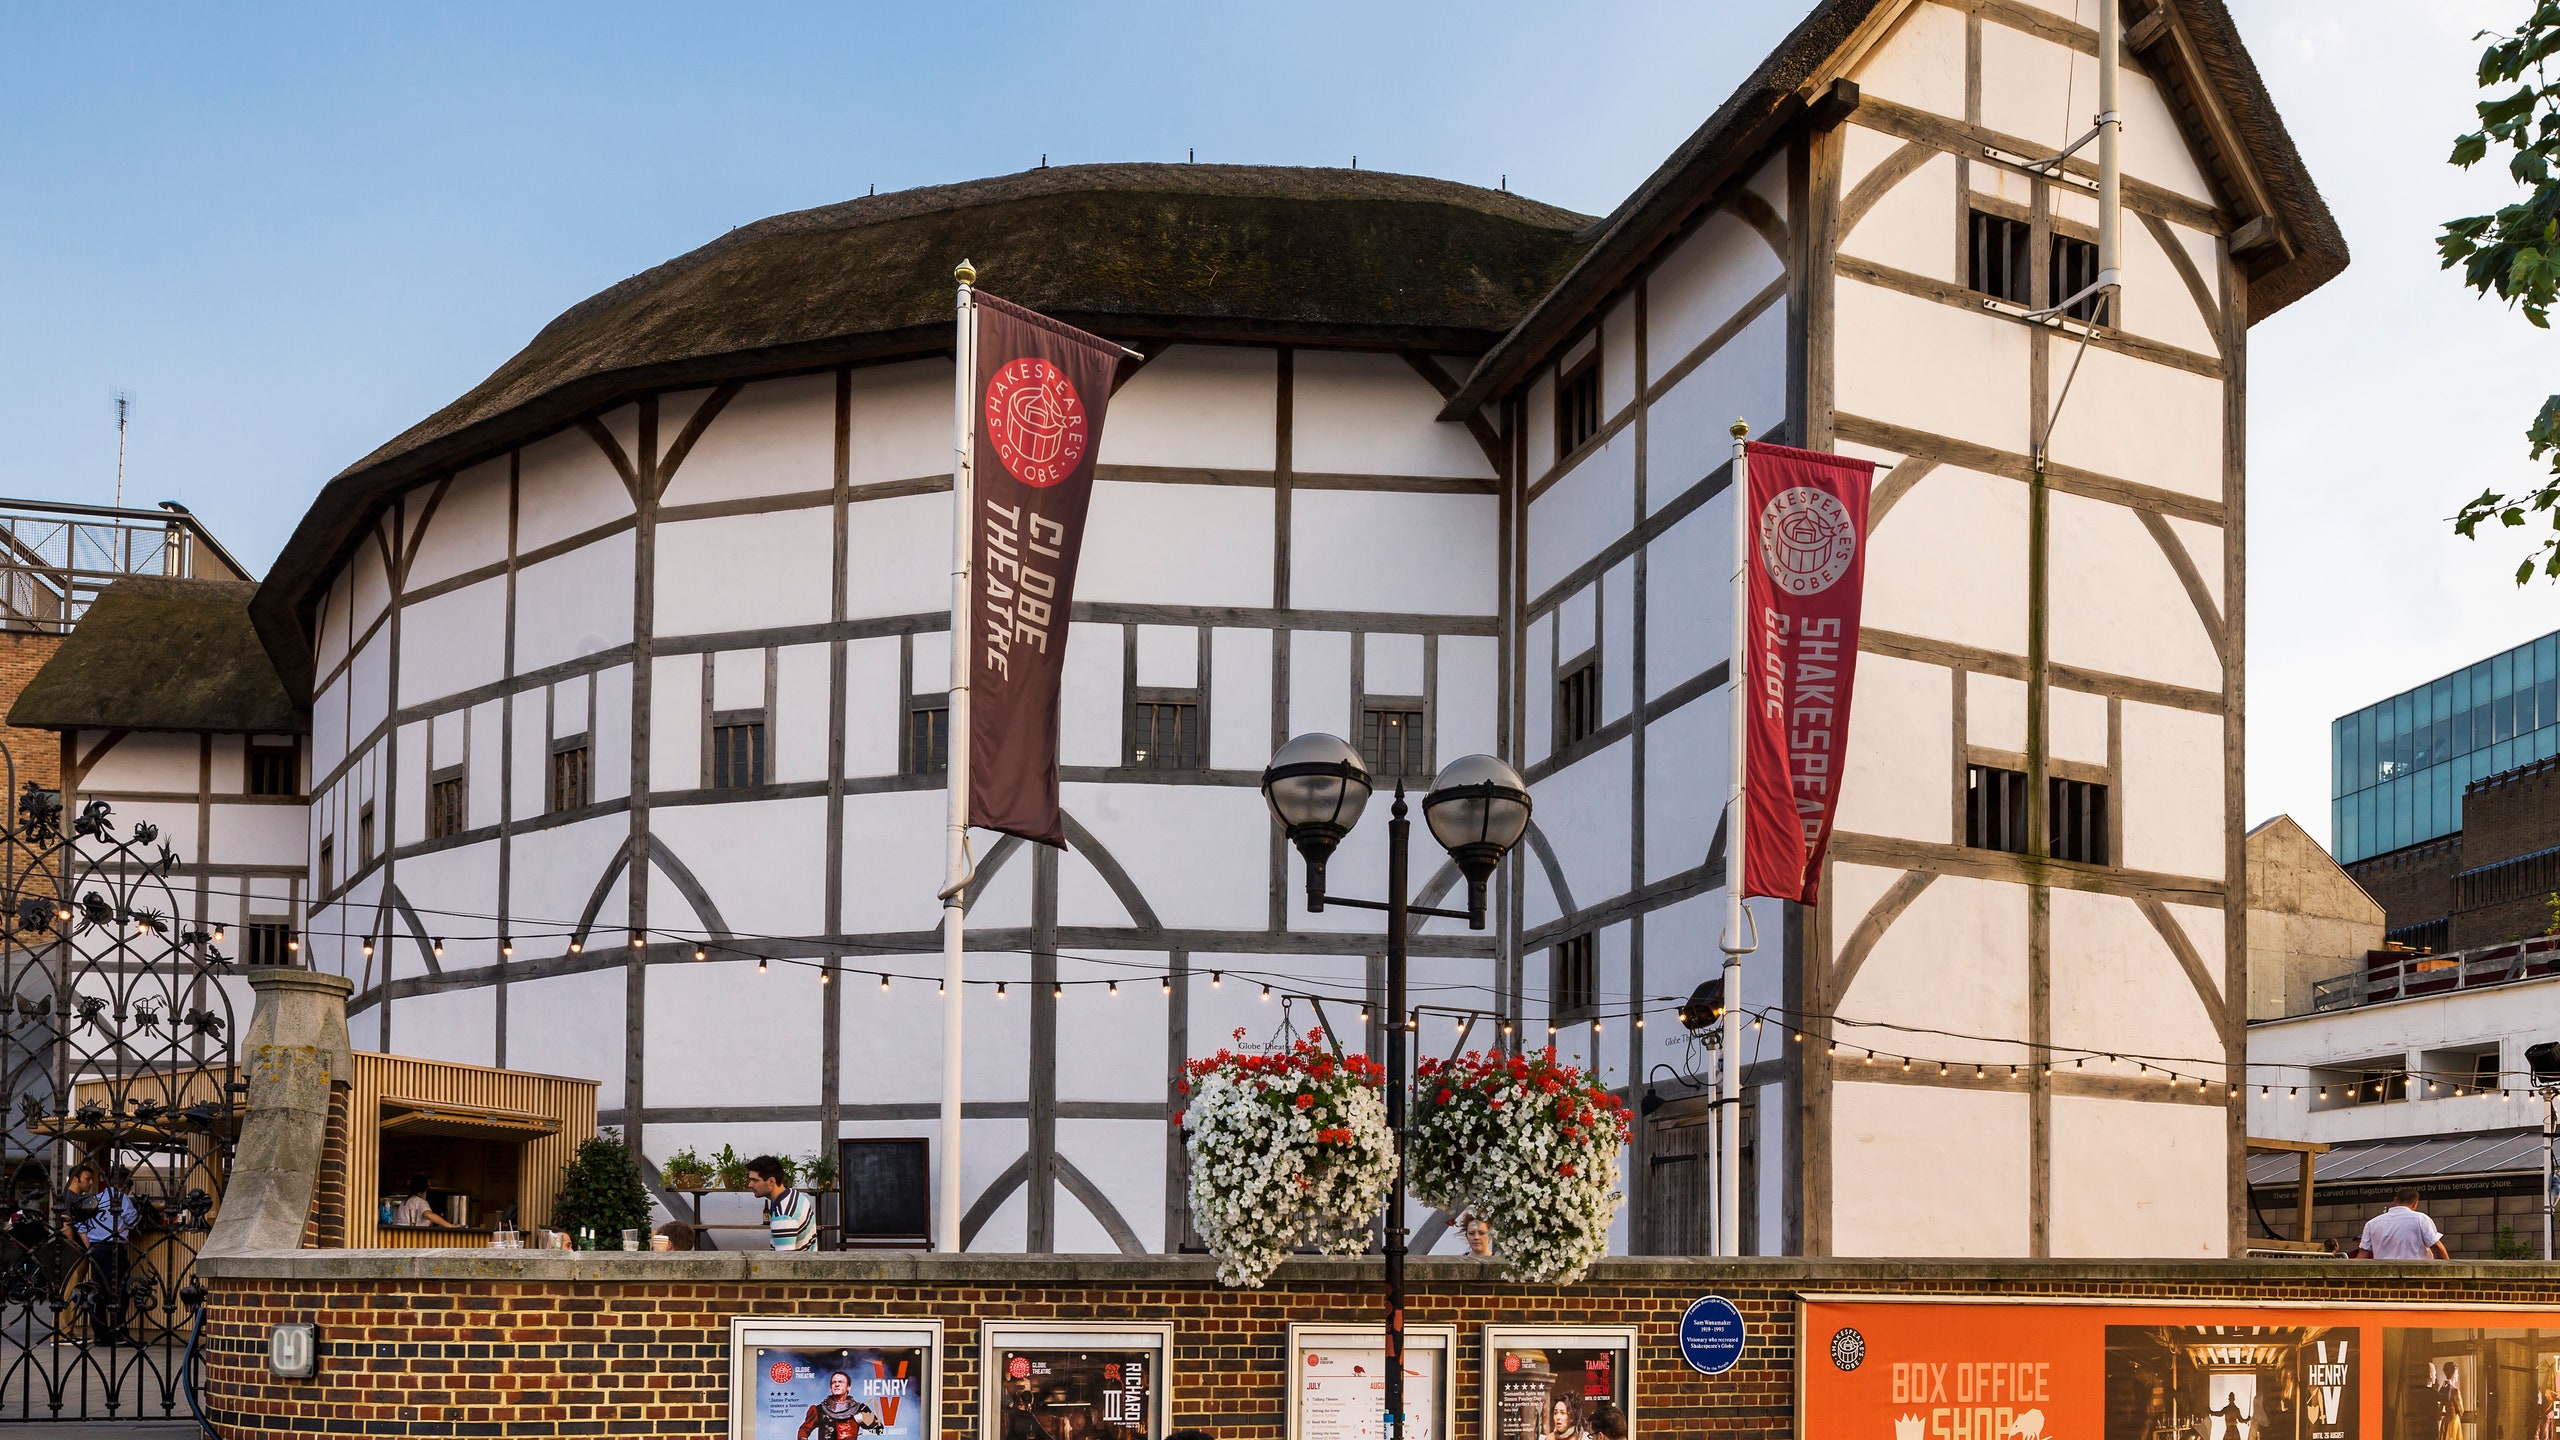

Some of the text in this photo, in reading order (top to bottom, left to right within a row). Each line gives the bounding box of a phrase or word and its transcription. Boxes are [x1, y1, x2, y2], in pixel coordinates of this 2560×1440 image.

[990, 364, 1082, 459] SHAKESPEARE'S
[1001, 444, 1060, 482] GLOBE
[1764, 491, 1851, 560] SHAKESPEARE'S
[985, 498, 1022, 683] THEATRE
[1773, 564, 1833, 590] GLOBE
[1765, 607, 1791, 721] GLOBE
[1263, 1042, 1292, 1050] Theat
[1665, 1036, 1681, 1046] Globe
[2323, 1190, 2344, 1198] carved
[2360, 1186, 2393, 1196] flagstones
[2428, 1184, 2436, 1192] by
[2452, 1182, 2490, 1192] temporary
[2491, 1180, 2512, 1188] Store.
[1585, 1360, 1610, 1370] TAMING
[1836, 1360, 1860, 1370] GLOBE
[2309, 1364, 2348, 1386] HENRY
[864, 1379, 908, 1396] HENRY
[1125, 1363, 1142, 1420] RICHARD
[1584, 1385, 1609, 1395] SHREW
[1892, 1362, 2050, 1404] BOX OFFICE
[1103, 1390, 1122, 1421] III
[1932, 1407, 2013, 1440] SHOP
